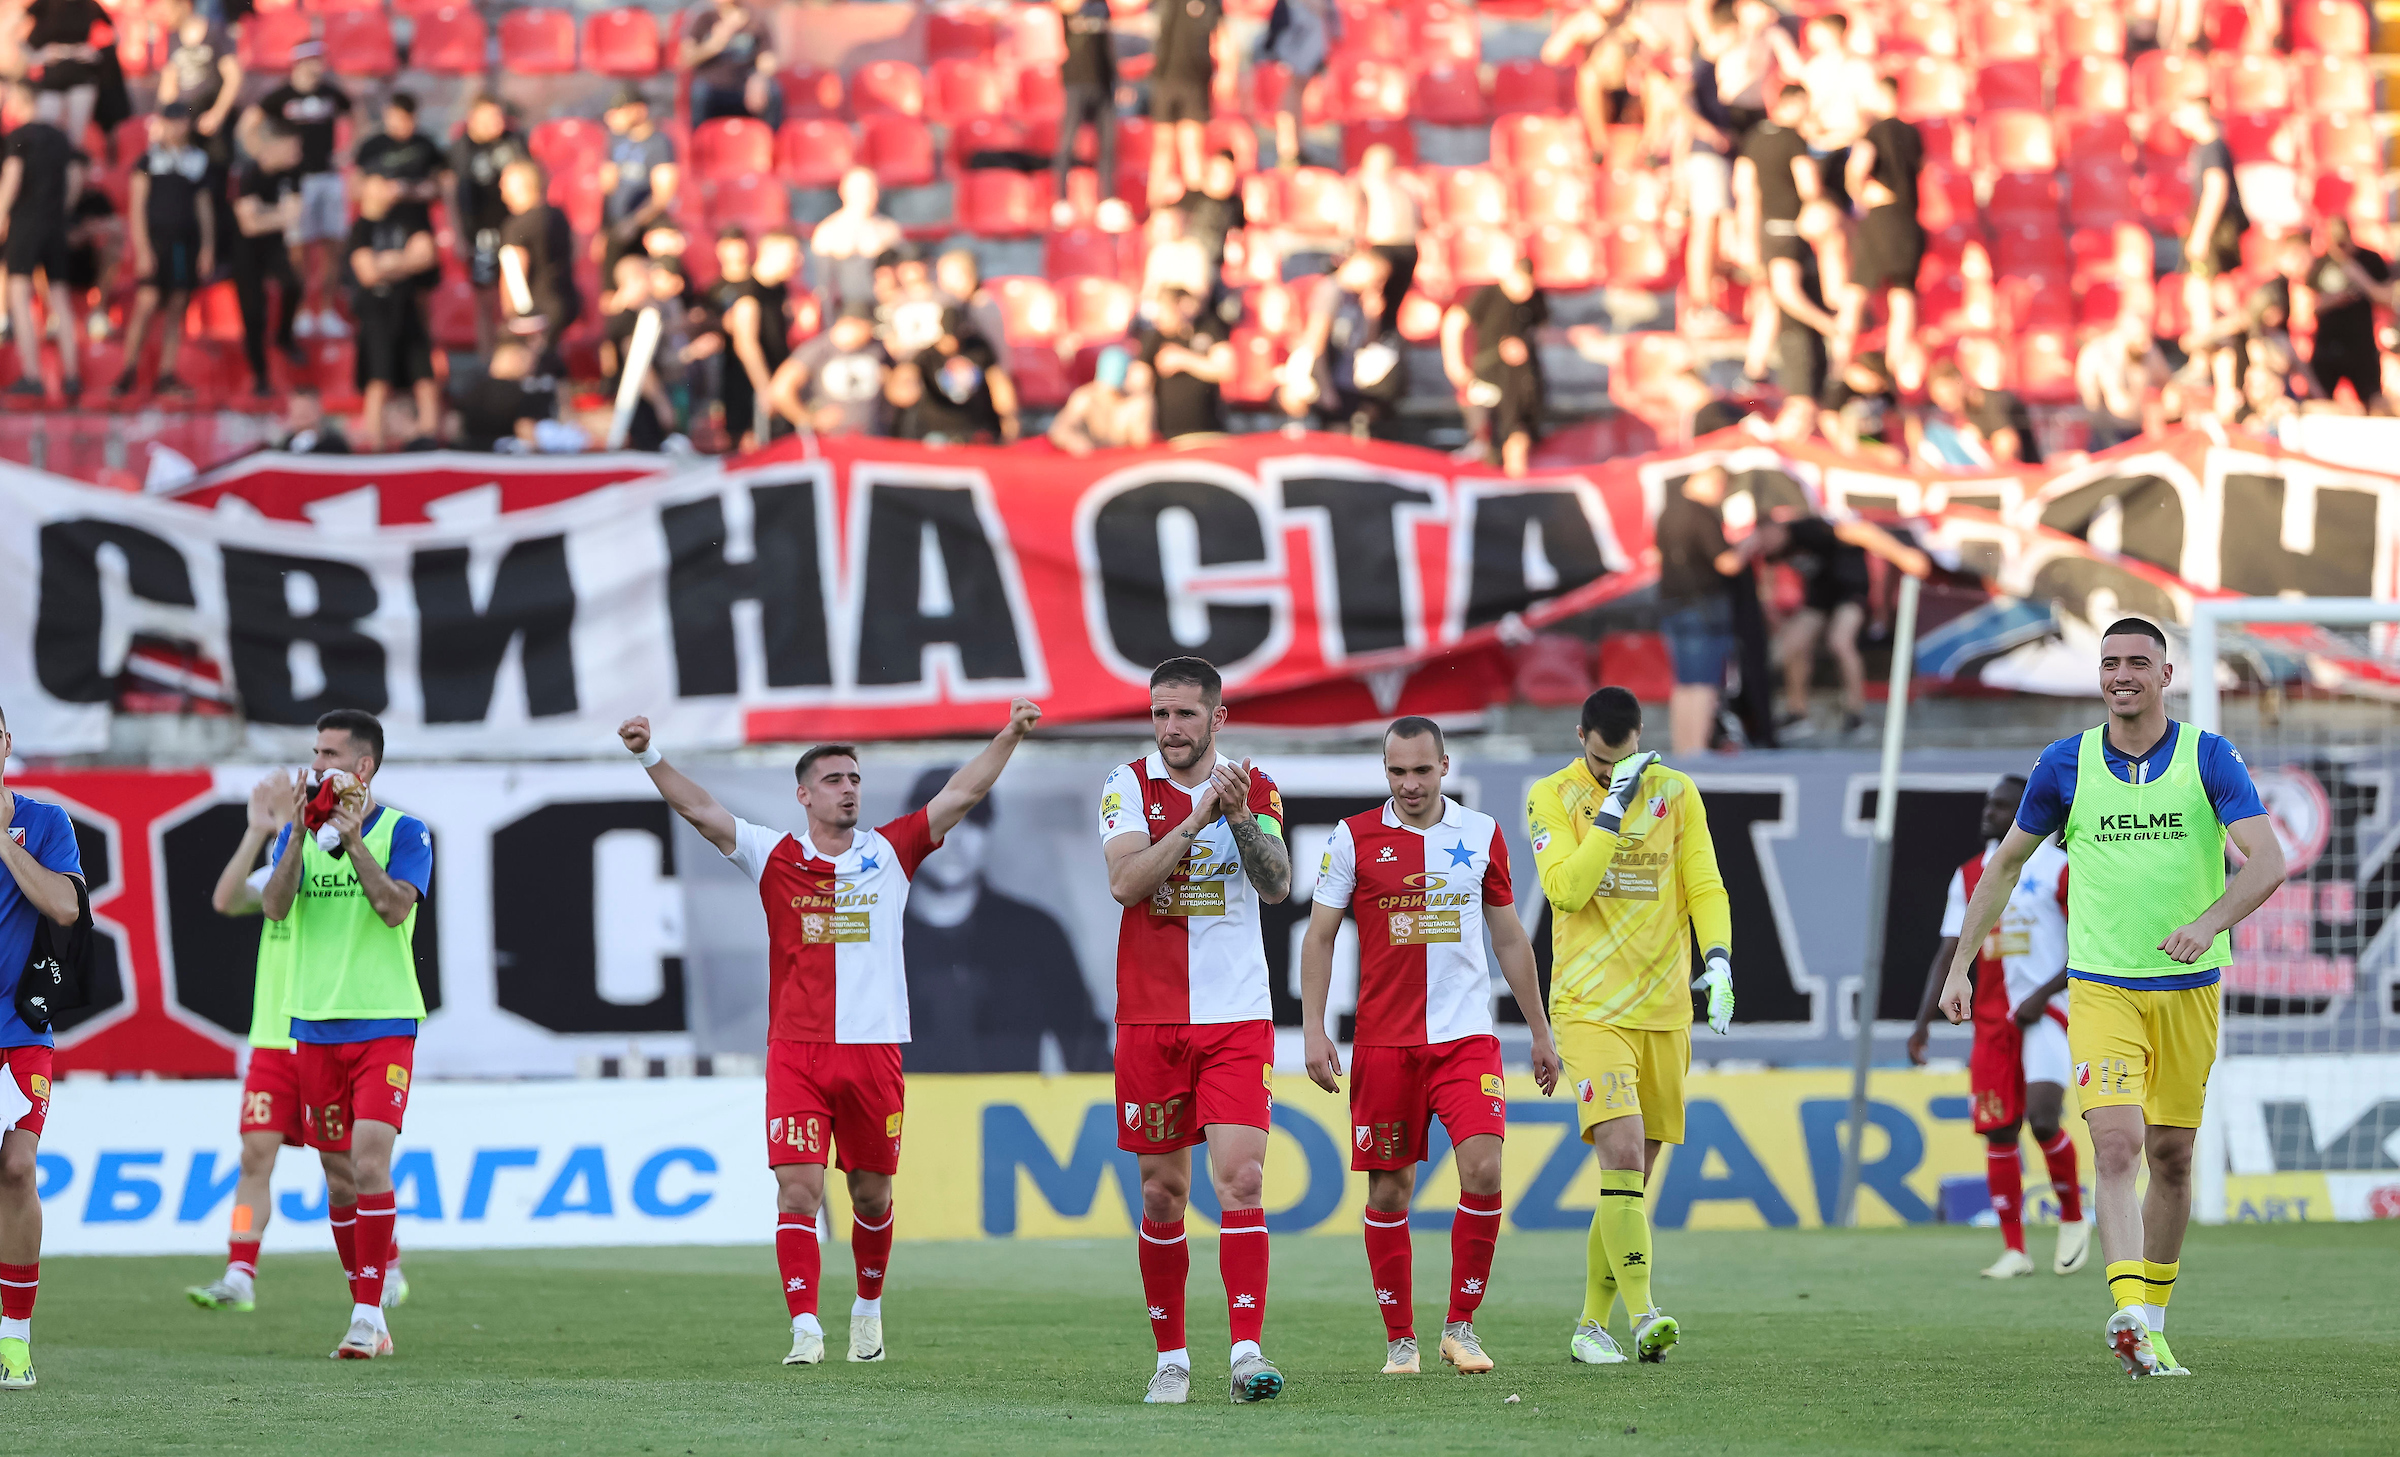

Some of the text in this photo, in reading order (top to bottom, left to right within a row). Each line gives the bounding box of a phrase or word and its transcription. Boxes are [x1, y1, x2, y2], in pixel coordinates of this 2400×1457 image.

[35, 470, 2376, 726] СВИ НА СТАОН
[2100, 813, 2183, 830] KELME
[2093, 832, 2131, 842] NEVER
[2134, 831, 2161, 841] GIVE
[1170, 862, 1239, 876] ИЈАГАС
[1611, 852, 1669, 865] ИЈАГАС
[311, 873, 360, 888] KELM
[790, 893, 879, 908] СРБИЈАГАС
[1378, 894, 1470, 909] СРБИЈАГАС
[2098, 1057, 2131, 1096] 12
[1601, 1071, 1637, 1110] 25
[243, 1090, 273, 1125] 26
[1144, 1098, 1185, 1142] 92
[312, 1103, 344, 1142] 16
[786, 1116, 821, 1153] 49
[1375, 1120, 1409, 1161] 50
[1460, 1286, 1482, 1295] KELME
